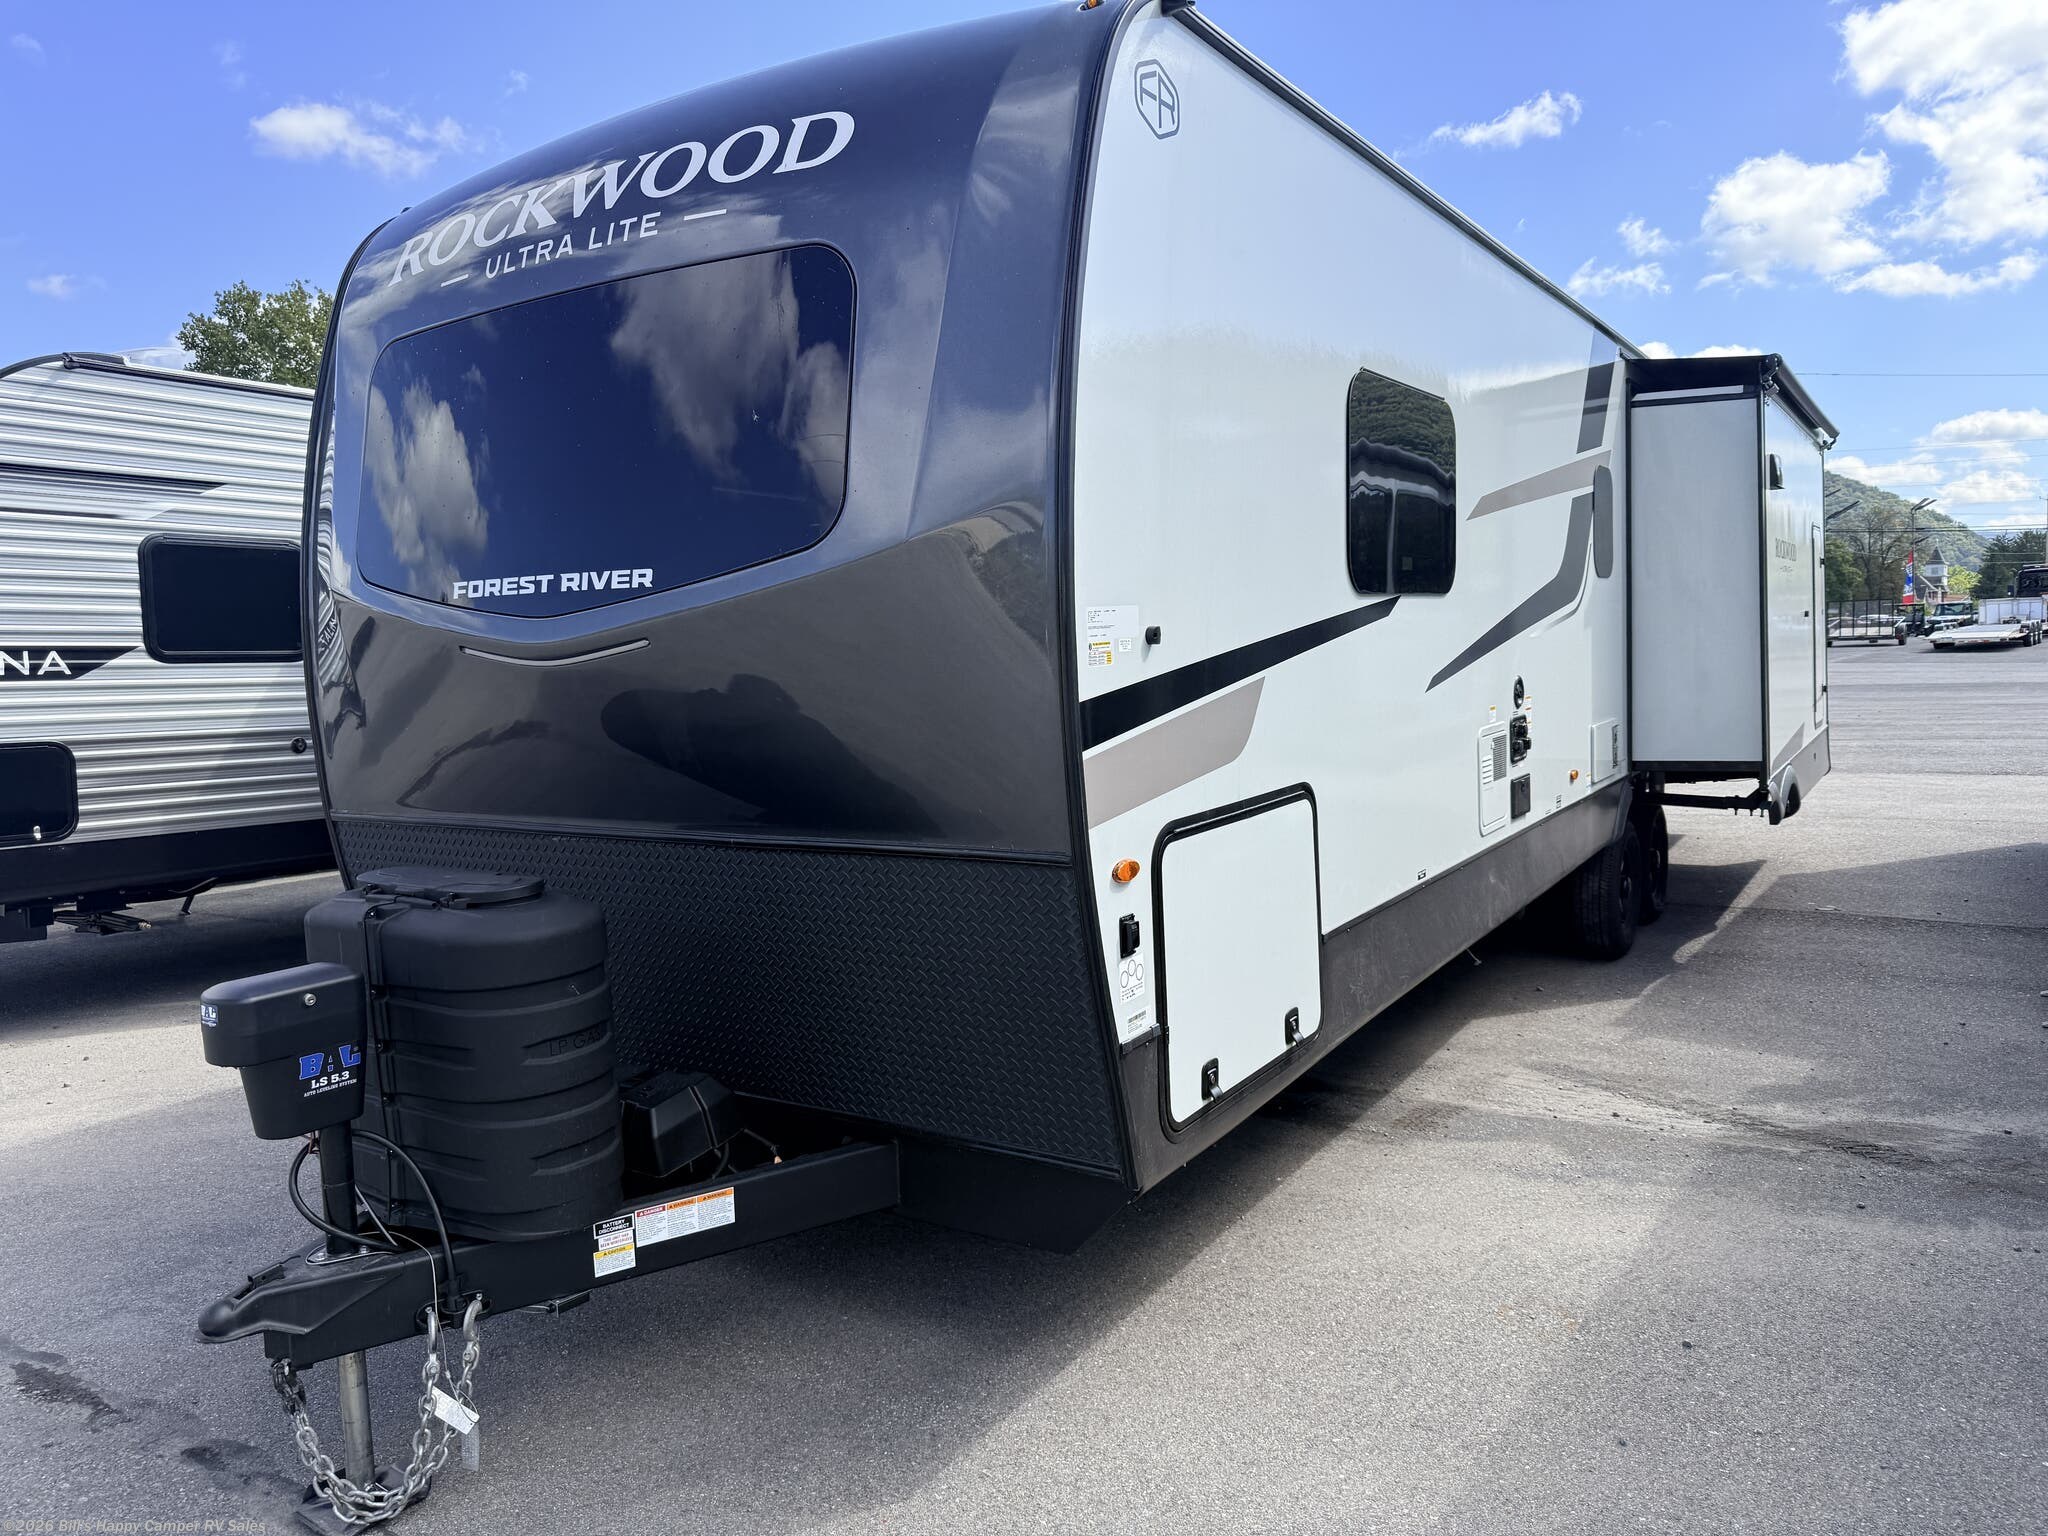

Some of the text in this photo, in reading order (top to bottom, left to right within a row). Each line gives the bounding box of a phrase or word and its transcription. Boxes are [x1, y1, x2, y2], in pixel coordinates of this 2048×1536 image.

[388, 111, 855, 287] ROCKWOOD
[485, 212, 661, 279] ULTRA LITE
[453, 568, 653, 599] FOREST RIVER
[311, 1070, 350, 1089] LS 5.3
[598, 1223, 630, 1235] DISCONNECT
[602, 1219, 625, 1229] BATTERY
